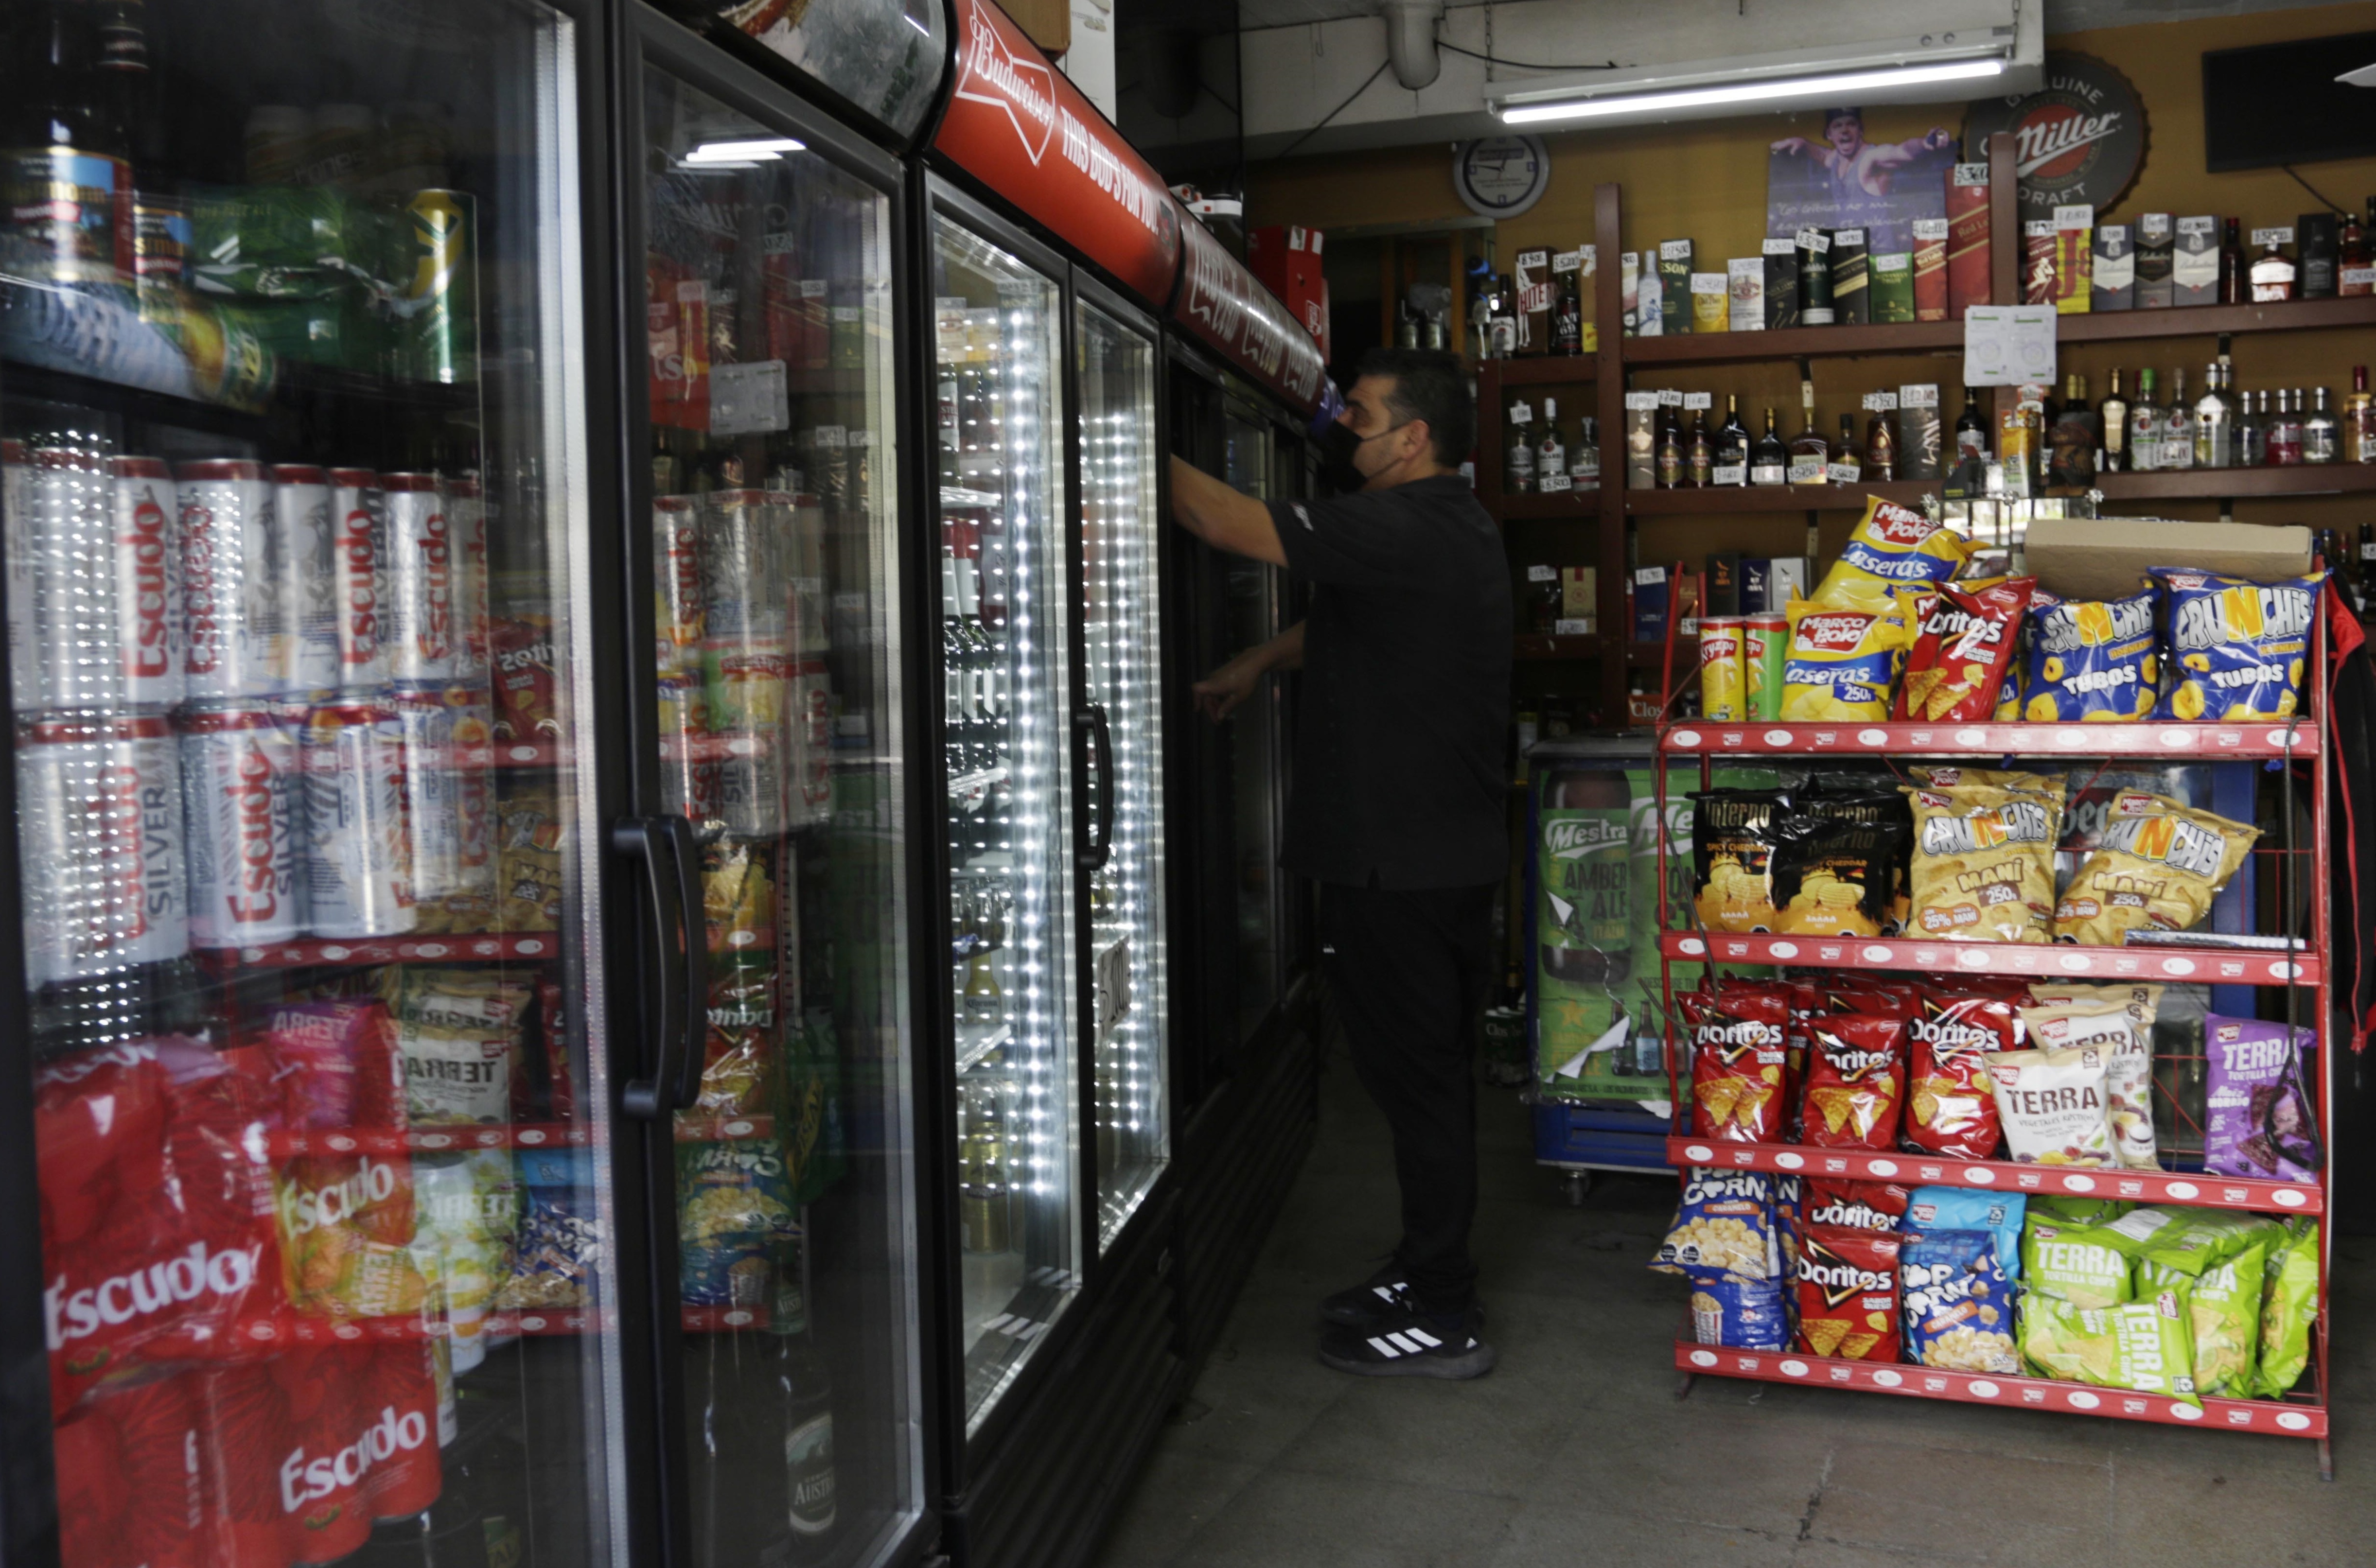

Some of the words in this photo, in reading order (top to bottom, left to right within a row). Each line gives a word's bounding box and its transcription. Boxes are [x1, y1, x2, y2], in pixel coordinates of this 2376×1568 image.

[969, 16, 1054, 126] Budweiser
[1061, 105, 1089, 174] THIS
[2017, 112, 2121, 163] Miller
[1800, 616, 1867, 631] MARCO
[1815, 627, 1863, 643] POLO
[1785, 661, 1870, 685] Caseras
[2063, 664, 2137, 696] TUBOS
[2211, 664, 2285, 689] TUBOS
[1552, 819, 1628, 849] Mestra
[1564, 863, 1627, 889] AMBER
[1590, 891, 1626, 920] ALE
[2006, 1087, 2100, 1115] TERRA
[1798, 1254, 1893, 1290] Doritos
[2036, 1241, 2125, 1279] TERRA
[44, 1241, 252, 1351] Escudo
[2121, 1303, 2165, 1390] TERRA
